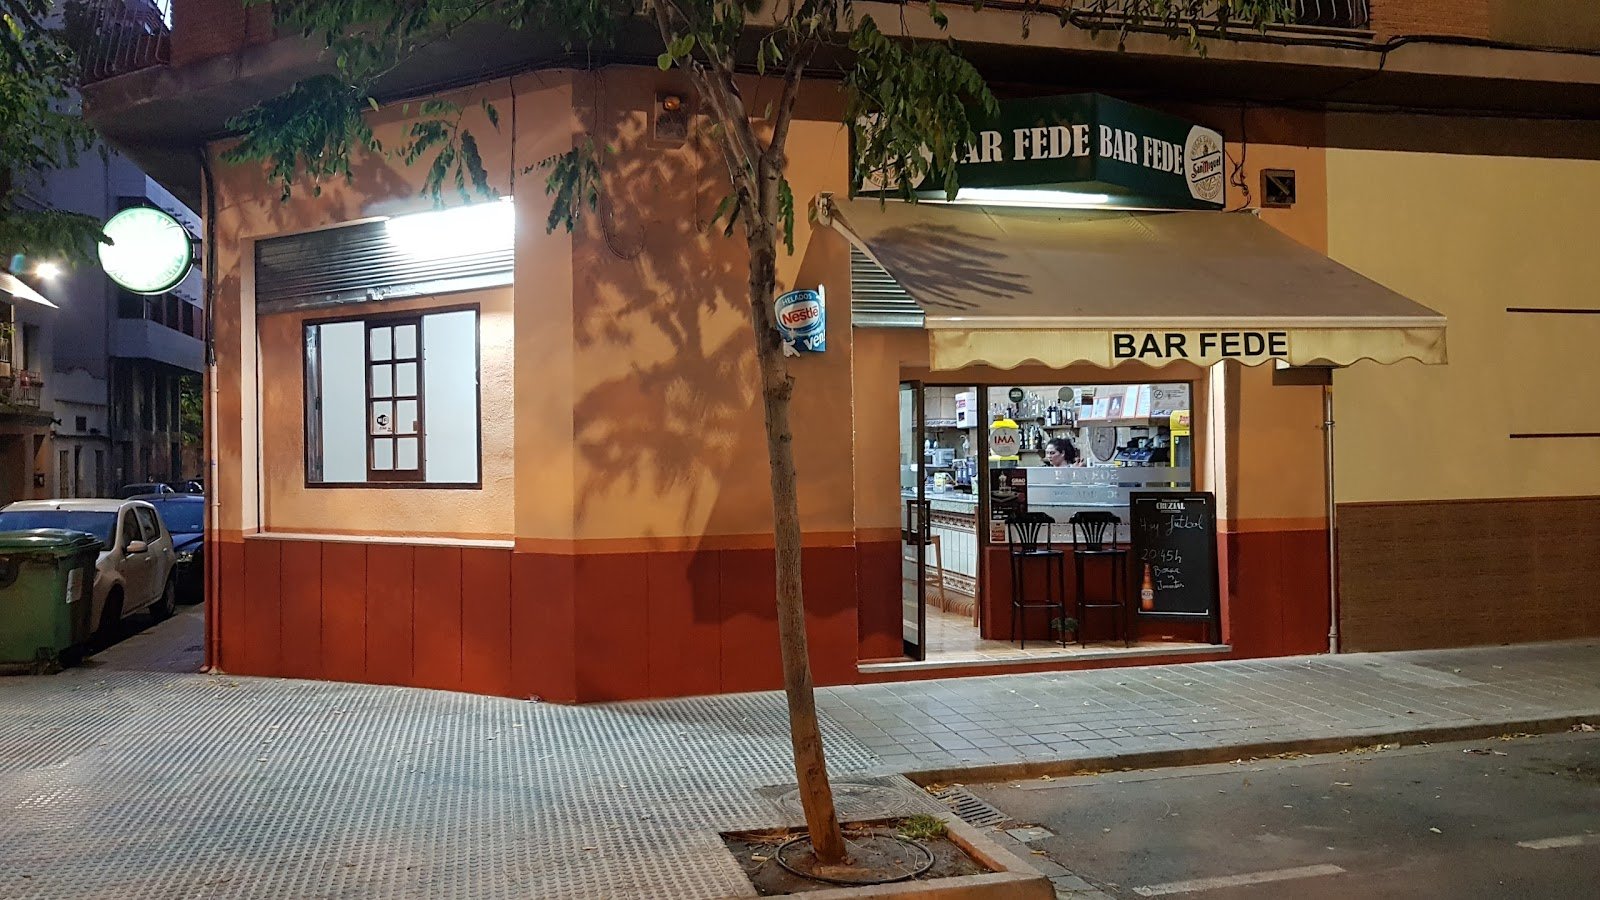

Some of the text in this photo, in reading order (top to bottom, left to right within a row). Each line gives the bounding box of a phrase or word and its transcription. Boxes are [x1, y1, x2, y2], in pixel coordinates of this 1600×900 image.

[949, 124, 1091, 164] AR FEDE
[1098, 123, 1139, 164] BAR
[1142, 135, 1184, 176] FEDE
[781, 292, 813, 306] HELADOS
[782, 304, 819, 325] Nestlé
[1113, 330, 1287, 359] BAR FEDE
